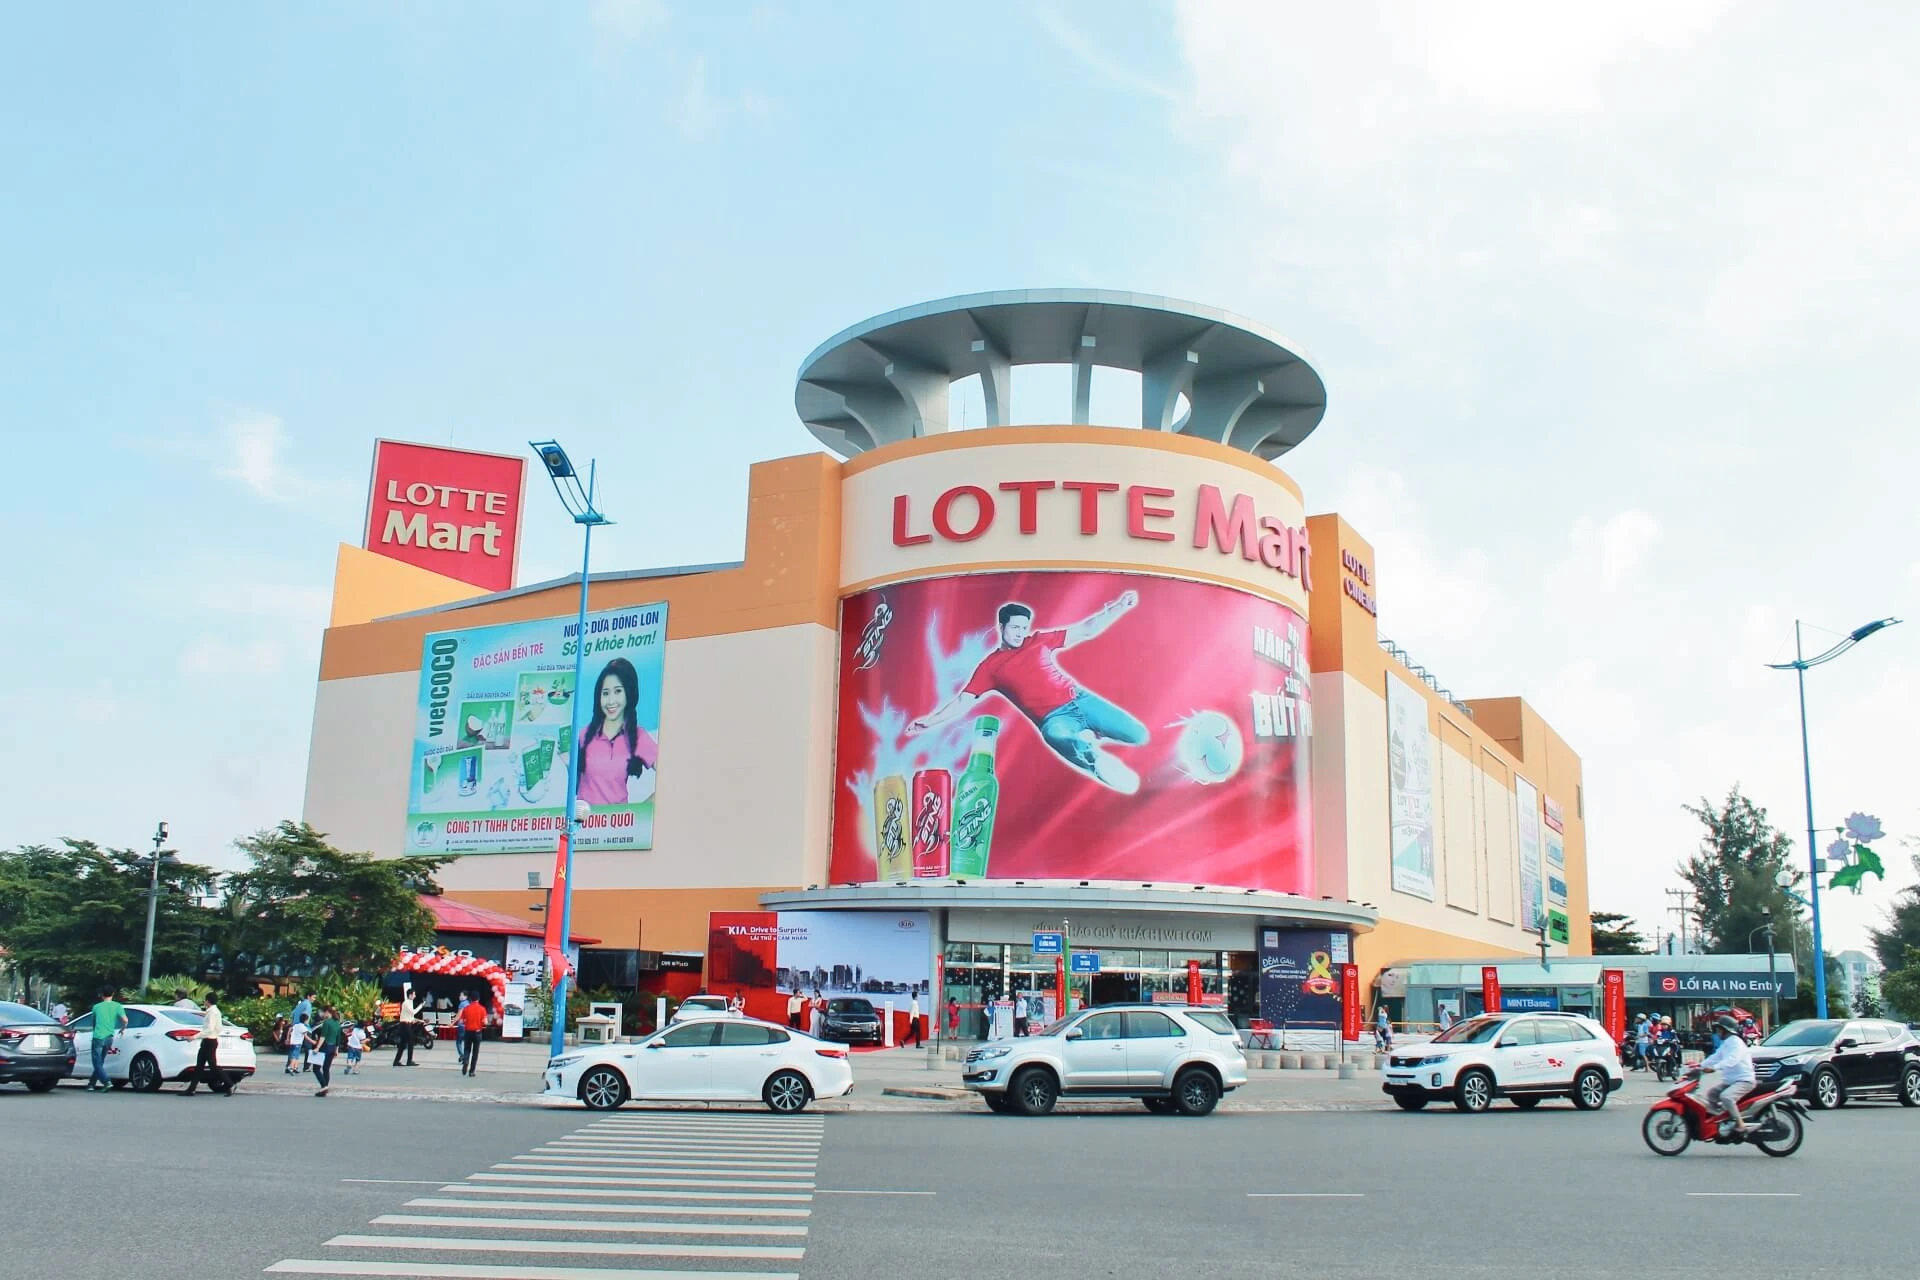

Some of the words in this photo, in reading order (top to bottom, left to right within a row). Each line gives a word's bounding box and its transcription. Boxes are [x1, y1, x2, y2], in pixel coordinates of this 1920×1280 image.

[387, 479, 508, 515] LOTTE
[381, 509, 502, 557] Mart
[893, 480, 1175, 547] LOTTE
[1192, 484, 1313, 592] Mart
[1343, 549, 1371, 586] LOTTE
[1344, 577, 1377, 618] CINEMA
[640, 611, 660, 626] LON
[530, 643, 544, 656] TRE
[594, 635, 625, 652] khỏe
[446, 818, 470, 834] CÔNG
[473, 820, 482, 833] TY
[486, 819, 508, 833] TNHH
[959, 804, 992, 840] STING
[728, 926, 747, 935] KIA
[779, 926, 808, 934] Surprise
[1680, 976, 1699, 990] LỐI
[1703, 980, 1720, 990] RA
[1730, 981, 1746, 990] No
